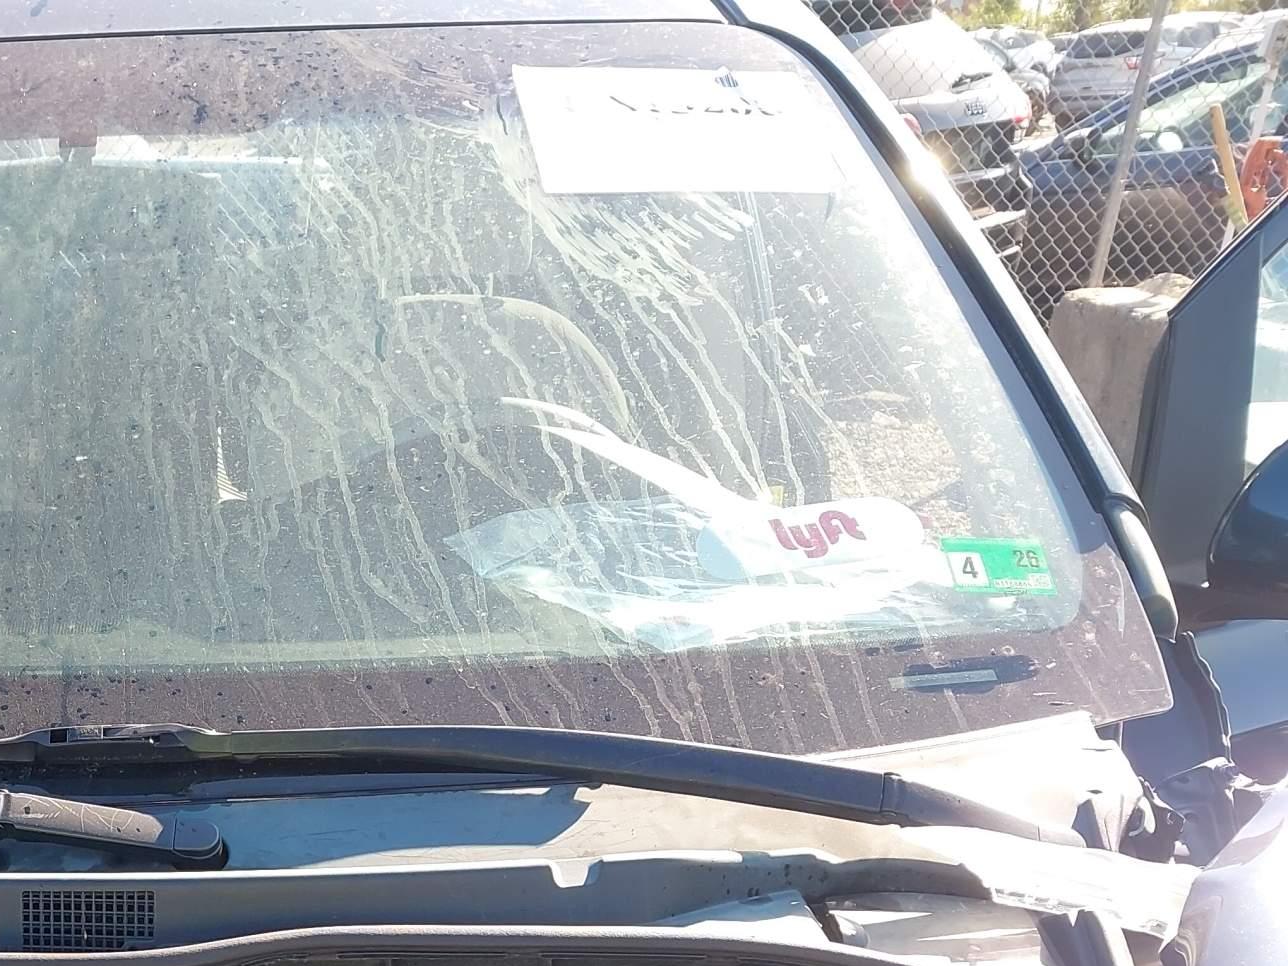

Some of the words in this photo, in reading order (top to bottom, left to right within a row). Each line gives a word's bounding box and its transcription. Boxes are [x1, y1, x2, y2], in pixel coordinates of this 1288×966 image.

[768, 510, 867, 559] lyft
[961, 556, 979, 579] 4
[1012, 549, 1041, 569] 26
